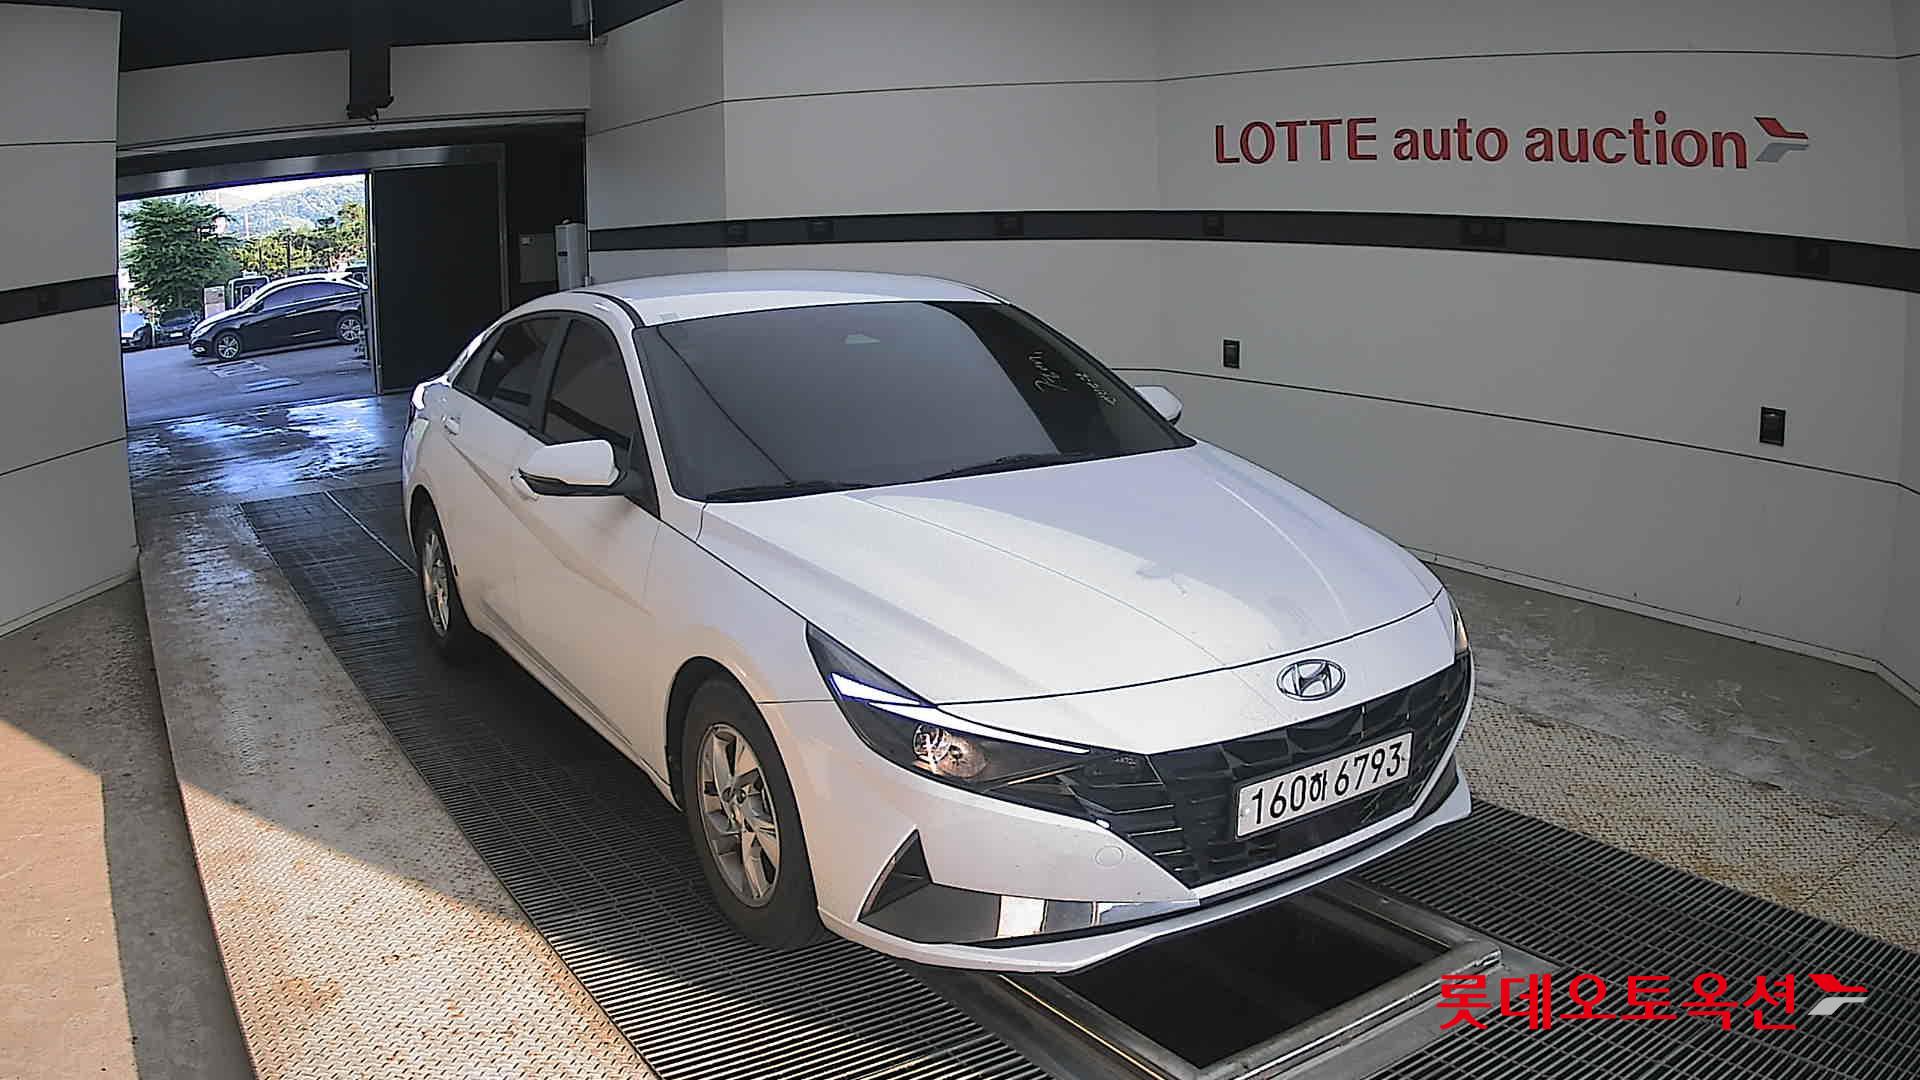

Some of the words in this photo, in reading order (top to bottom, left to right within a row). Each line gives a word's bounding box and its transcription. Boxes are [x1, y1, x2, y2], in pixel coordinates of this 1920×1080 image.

[1215, 117, 1377, 163] LOTTE
[1393, 118, 1508, 162] auto
[1524, 110, 1748, 169] auction
[1334, 741, 1403, 796] 6793
